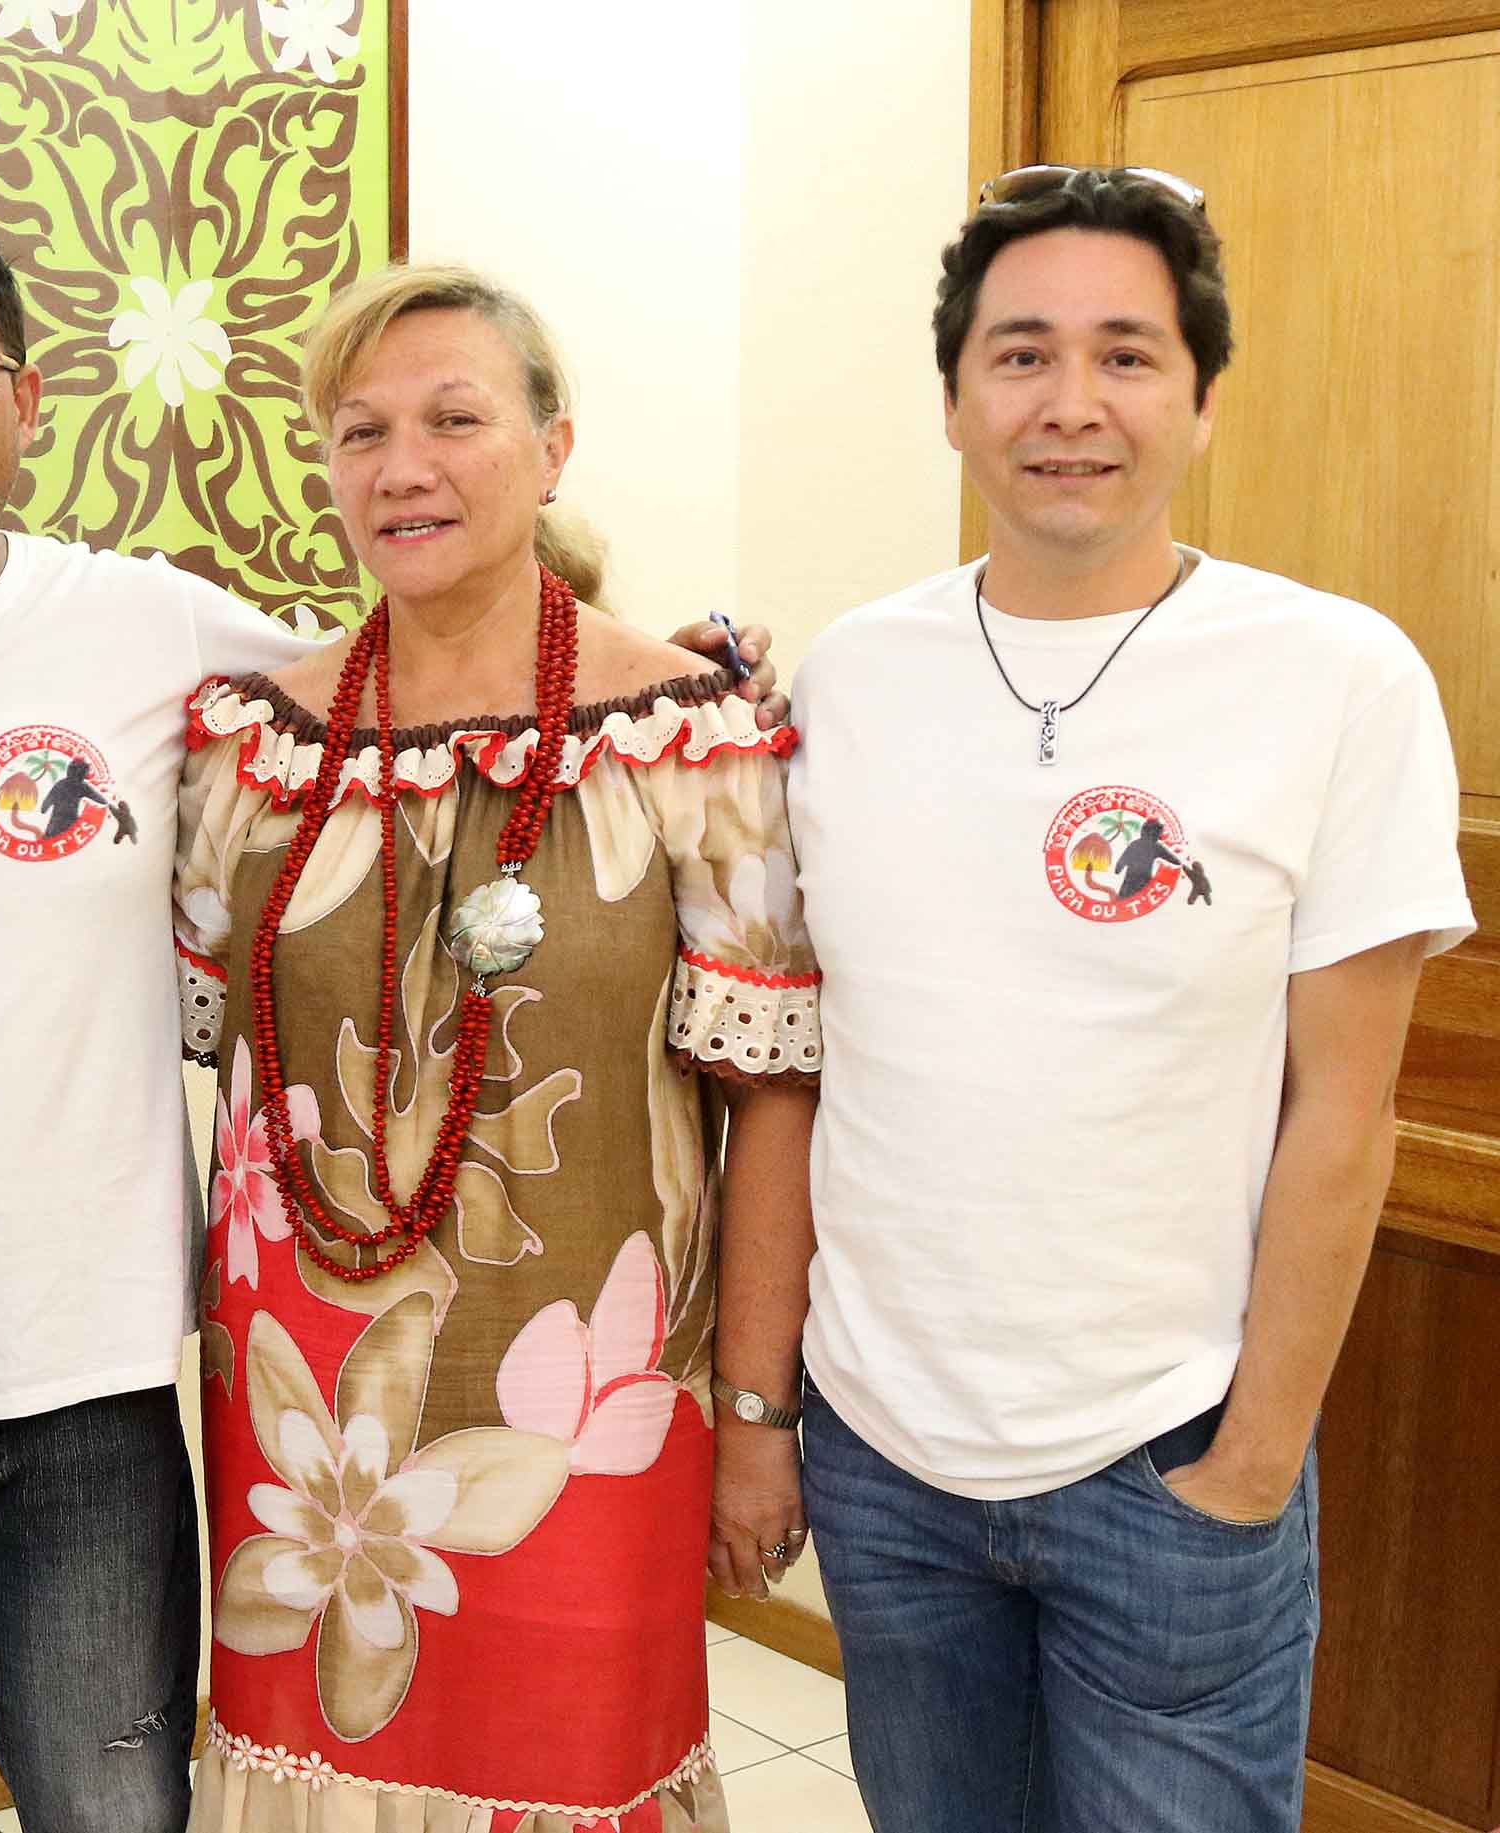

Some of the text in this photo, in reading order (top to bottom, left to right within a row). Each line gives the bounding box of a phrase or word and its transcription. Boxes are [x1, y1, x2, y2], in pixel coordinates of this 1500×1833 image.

[52, 821, 96, 854] T'ES
[1048, 865, 1084, 910] PAPA
[1126, 882, 1170, 915] T'ES
